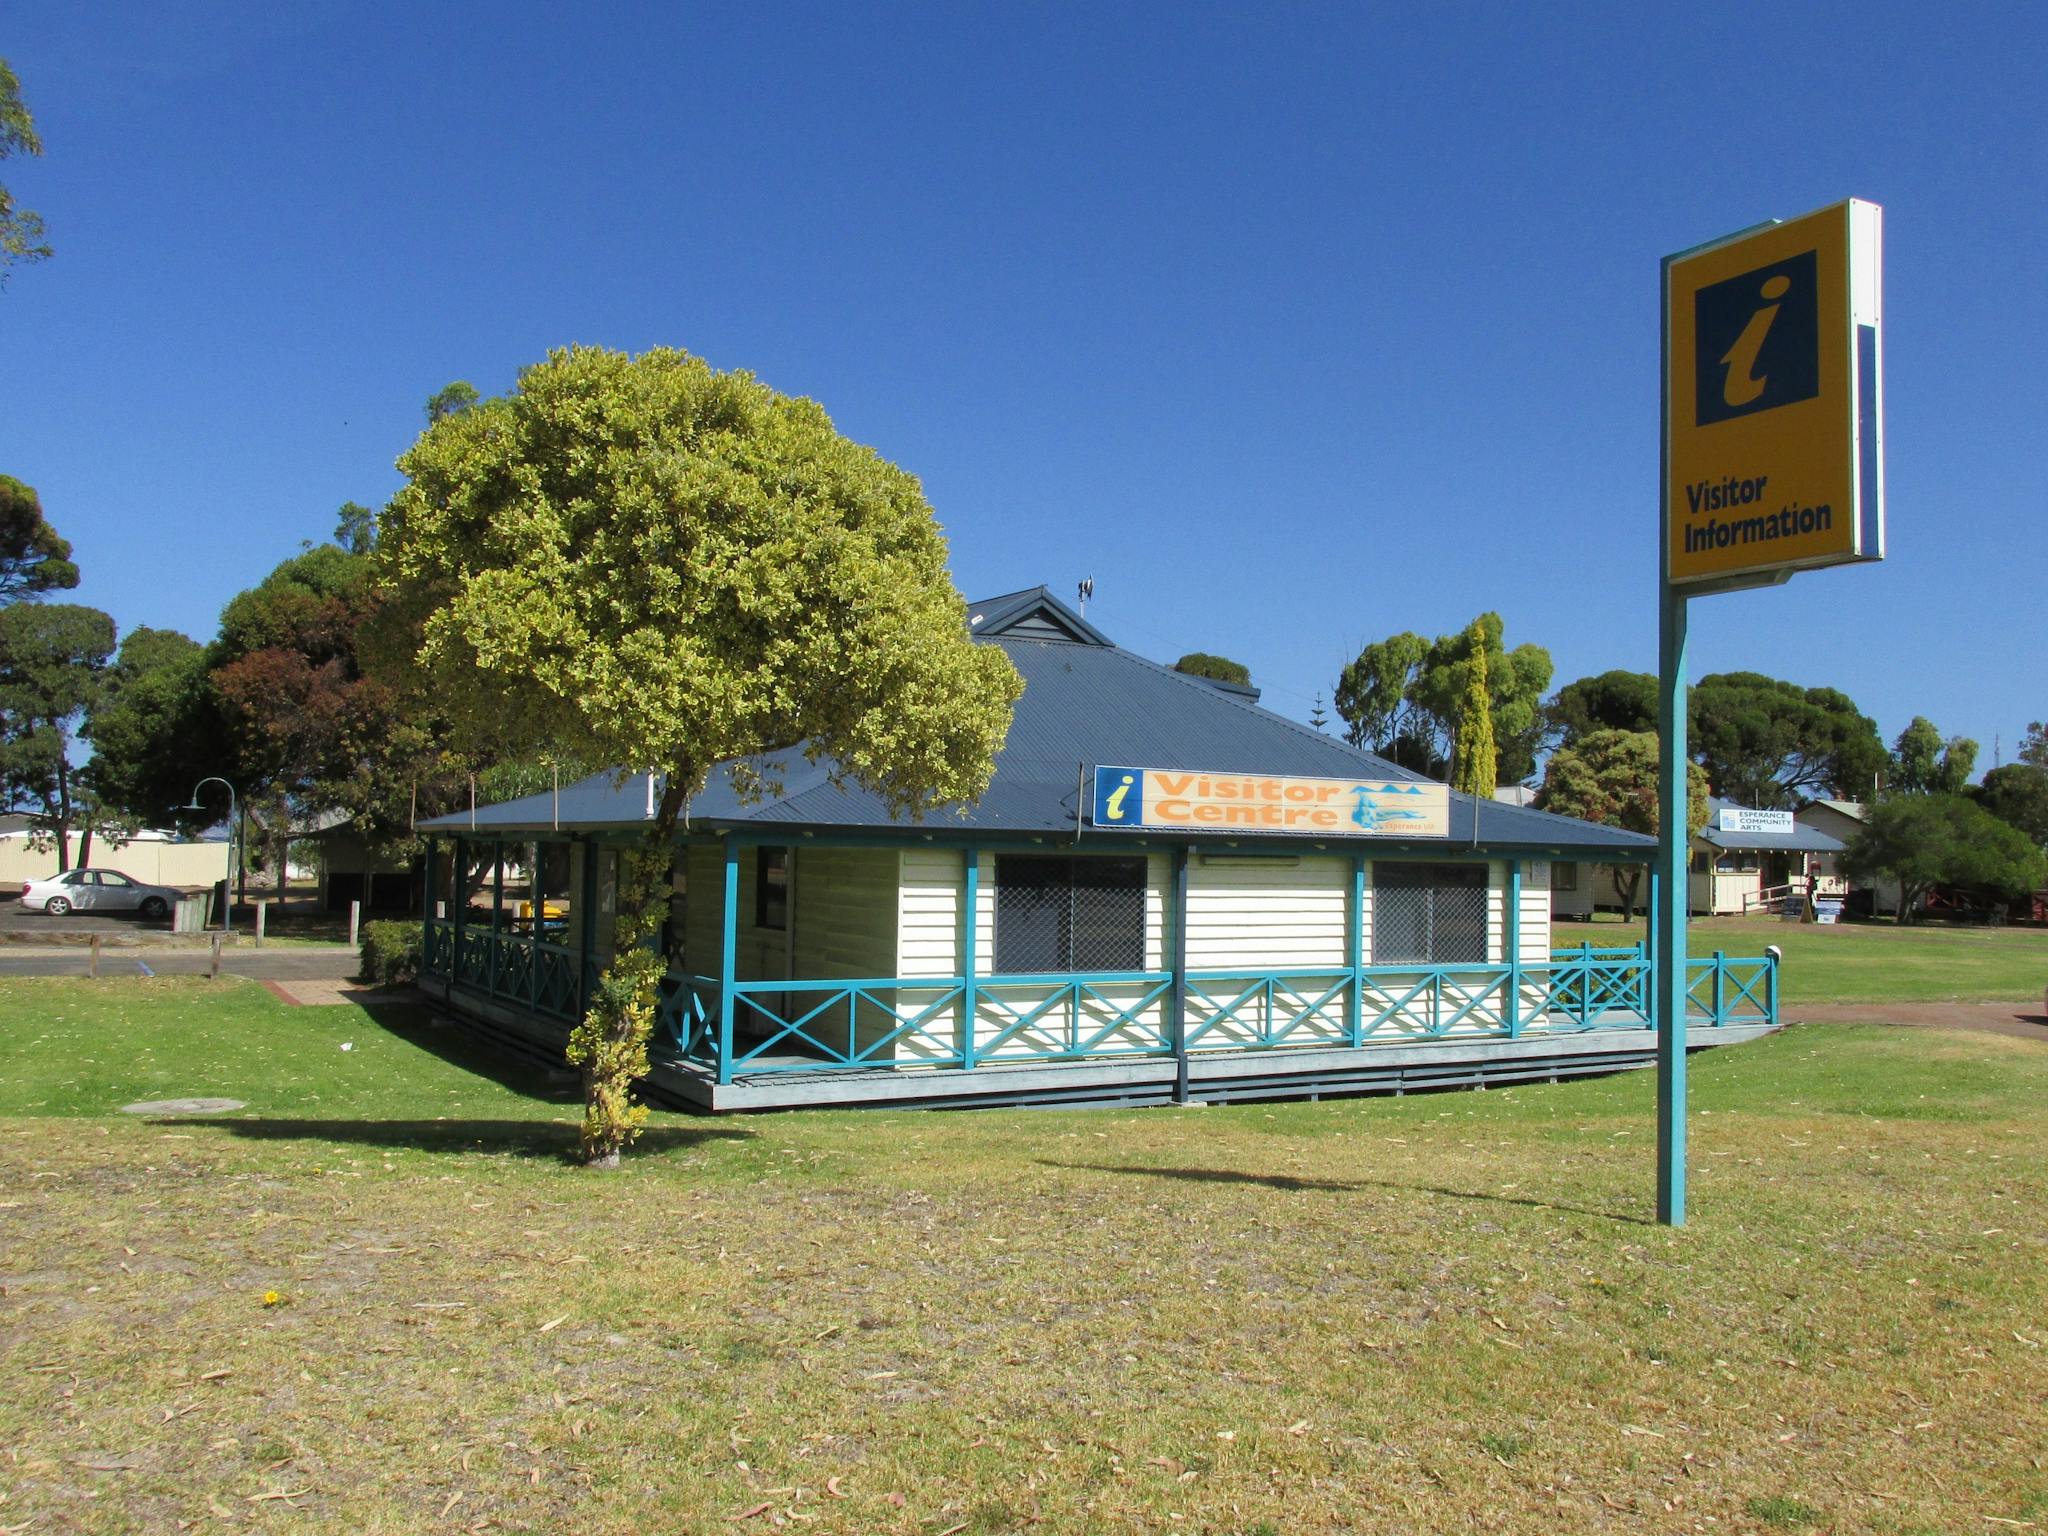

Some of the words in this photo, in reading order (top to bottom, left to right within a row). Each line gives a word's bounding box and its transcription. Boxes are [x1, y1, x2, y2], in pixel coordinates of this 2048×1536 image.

[1685, 475, 1768, 515] Visitor
[1684, 501, 1832, 554] Information
[1154, 774, 1341, 803] Visitor
[1154, 800, 1339, 826] Centre
[1739, 811, 1786, 819] ESPERANCE
